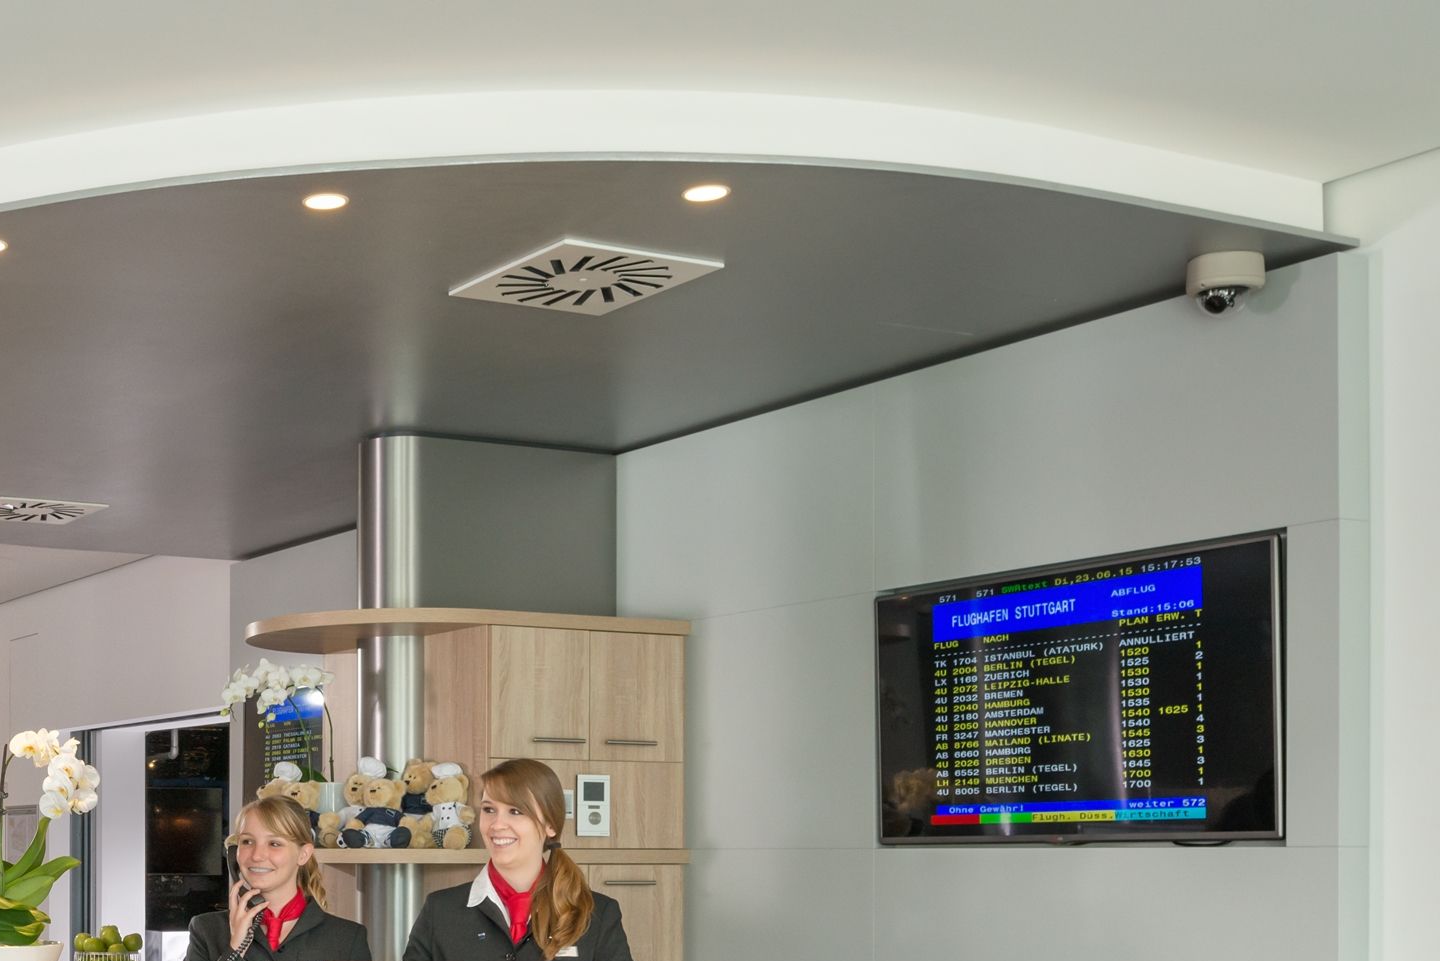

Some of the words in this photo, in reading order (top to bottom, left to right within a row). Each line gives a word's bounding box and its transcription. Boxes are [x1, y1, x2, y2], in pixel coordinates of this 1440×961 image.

[940, 594, 956, 603] 571
[976, 588, 994, 598] 571
[1141, 556, 1201, 572] 15:17:53
[1111, 584, 1155, 597] ABFLUG
[952, 608, 1008, 628] FLUGHAFEN
[1015, 598, 1075, 619] STUTTGART
[1112, 599, 1194, 617] Stand:15:06
[935, 640, 958, 650] FLUG
[983, 634, 1008, 643] NACH
[1119, 616, 1148, 626] PLAN
[1156, 611, 1185, 622] ERW.
[1195, 608, 1202, 617] T
[935, 660, 946, 668] TK
[954, 657, 977, 666] 1704
[984, 650, 1035, 662] ISTANBUL
[1044, 641, 1102, 655] (ATATURK)
[1119, 631, 1194, 647] ANNULLIERT
[935, 669, 946, 677] 4U
[953, 666, 977, 675] 2004
[984, 661, 1022, 672] BERLIN
[1030, 655, 1074, 666] (TEGEL)
[1121, 646, 1148, 657] 1520
[1197, 640, 1202, 648] 1
[953, 685, 977, 693] 2072
[984, 675, 1069, 690] LEIPZIG-HALLE
[1121, 667, 1149, 677] 1530
[1197, 661, 1202, 669] 1
[984, 670, 1028, 681] ZUERICH
[1121, 657, 1148, 667] 1525
[1196, 651, 1203, 659] 2
[954, 694, 977, 703] 2032
[984, 689, 1022, 700] BREMEN
[1121, 677, 1149, 687] 1530
[1197, 672, 1202, 680] 1
[954, 703, 977, 712] 2040
[985, 698, 1029, 709] HAMBURG
[1121, 687, 1149, 697] 1530
[1197, 682, 1202, 690] 1
[936, 724, 947, 732] 4U
[954, 722, 978, 730] 2050
[985, 717, 1036, 728] HANNOVER
[1121, 708, 1149, 717] 1540
[1159, 705, 1188, 714] 1625
[1198, 703, 1203, 711] 1
[985, 707, 1042, 718] AMSTERDAM
[1121, 698, 1149, 707] 1535
[1197, 693, 1203, 701] 1
[936, 733, 947, 741] FR
[954, 731, 978, 739] 3247
[985, 726, 1049, 737] MANCHESTER
[1122, 718, 1149, 727] 1540
[1197, 714, 1204, 722] 4
[954, 740, 978, 749] 8766
[985, 737, 1029, 747] MAILAND
[1038, 733, 1090, 743] (LINATE)
[1122, 728, 1149, 737] 1545
[954, 750, 978, 758] 6660
[985, 746, 1030, 756] HAMBURG
[1122, 739, 1150, 747] 1625
[1197, 735, 1204, 743] 3
[955, 759, 978, 767] 2026
[985, 756, 1030, 765] DRESDEN
[1122, 749, 1150, 758] 1630
[955, 768, 979, 776] 6552
[986, 766, 1023, 775] BERLIN
[1032, 763, 1076, 772] (TEGEL)
[1122, 759, 1150, 768] 1645
[1197, 756, 1204, 764] 3
[986, 775, 1037, 784] MUENCHEN
[1122, 769, 1150, 778] 1700
[986, 785, 1024, 793] BERLIN
[1032, 783, 1076, 791] (TEGEL)
[1123, 780, 1150, 788] 1700
[1199, 777, 1204, 785] 1
[1129, 799, 1173, 808] weiter
[1182, 798, 1205, 806] 572
